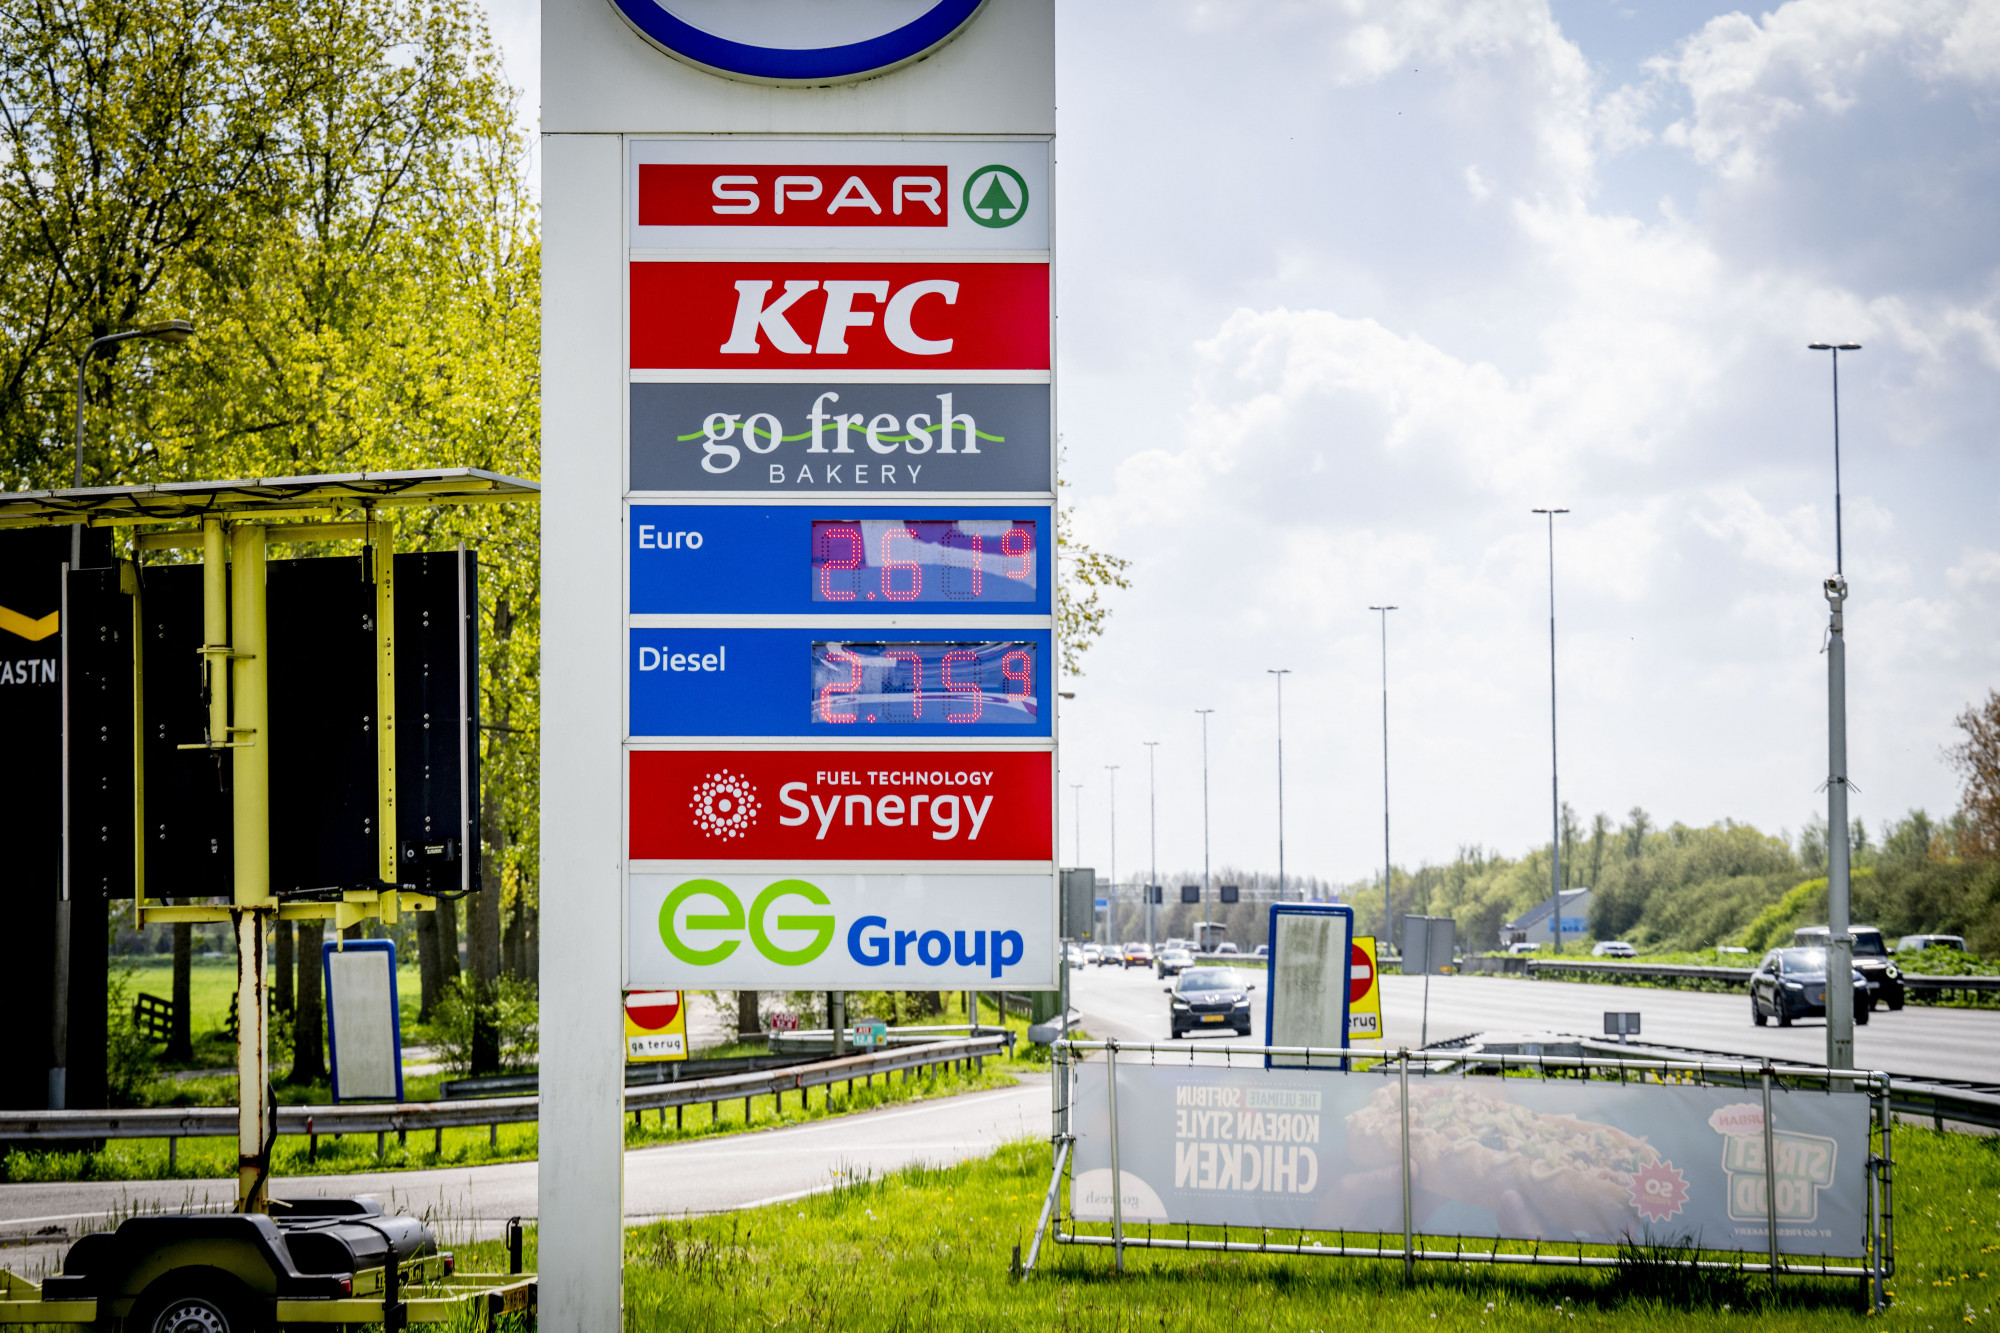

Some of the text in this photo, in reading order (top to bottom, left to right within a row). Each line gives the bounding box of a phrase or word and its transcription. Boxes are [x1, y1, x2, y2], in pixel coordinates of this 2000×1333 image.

[711, 175, 942, 215] SPAR
[719, 279, 960, 356] KFC
[700, 391, 981, 474] go fresh
[769, 464, 922, 484] BAKERY
[638, 524, 704, 551] Euro
[0, 658, 56, 685] ASTN
[638, 646, 726, 673] Diesel
[816, 771, 994, 786] FUEL TECHNOLOGY
[778, 781, 995, 841] Synergy
[847, 915, 1024, 979] Group
[1349, 1016, 1377, 1030] rug
[631, 1040, 681, 1053] ga terug
